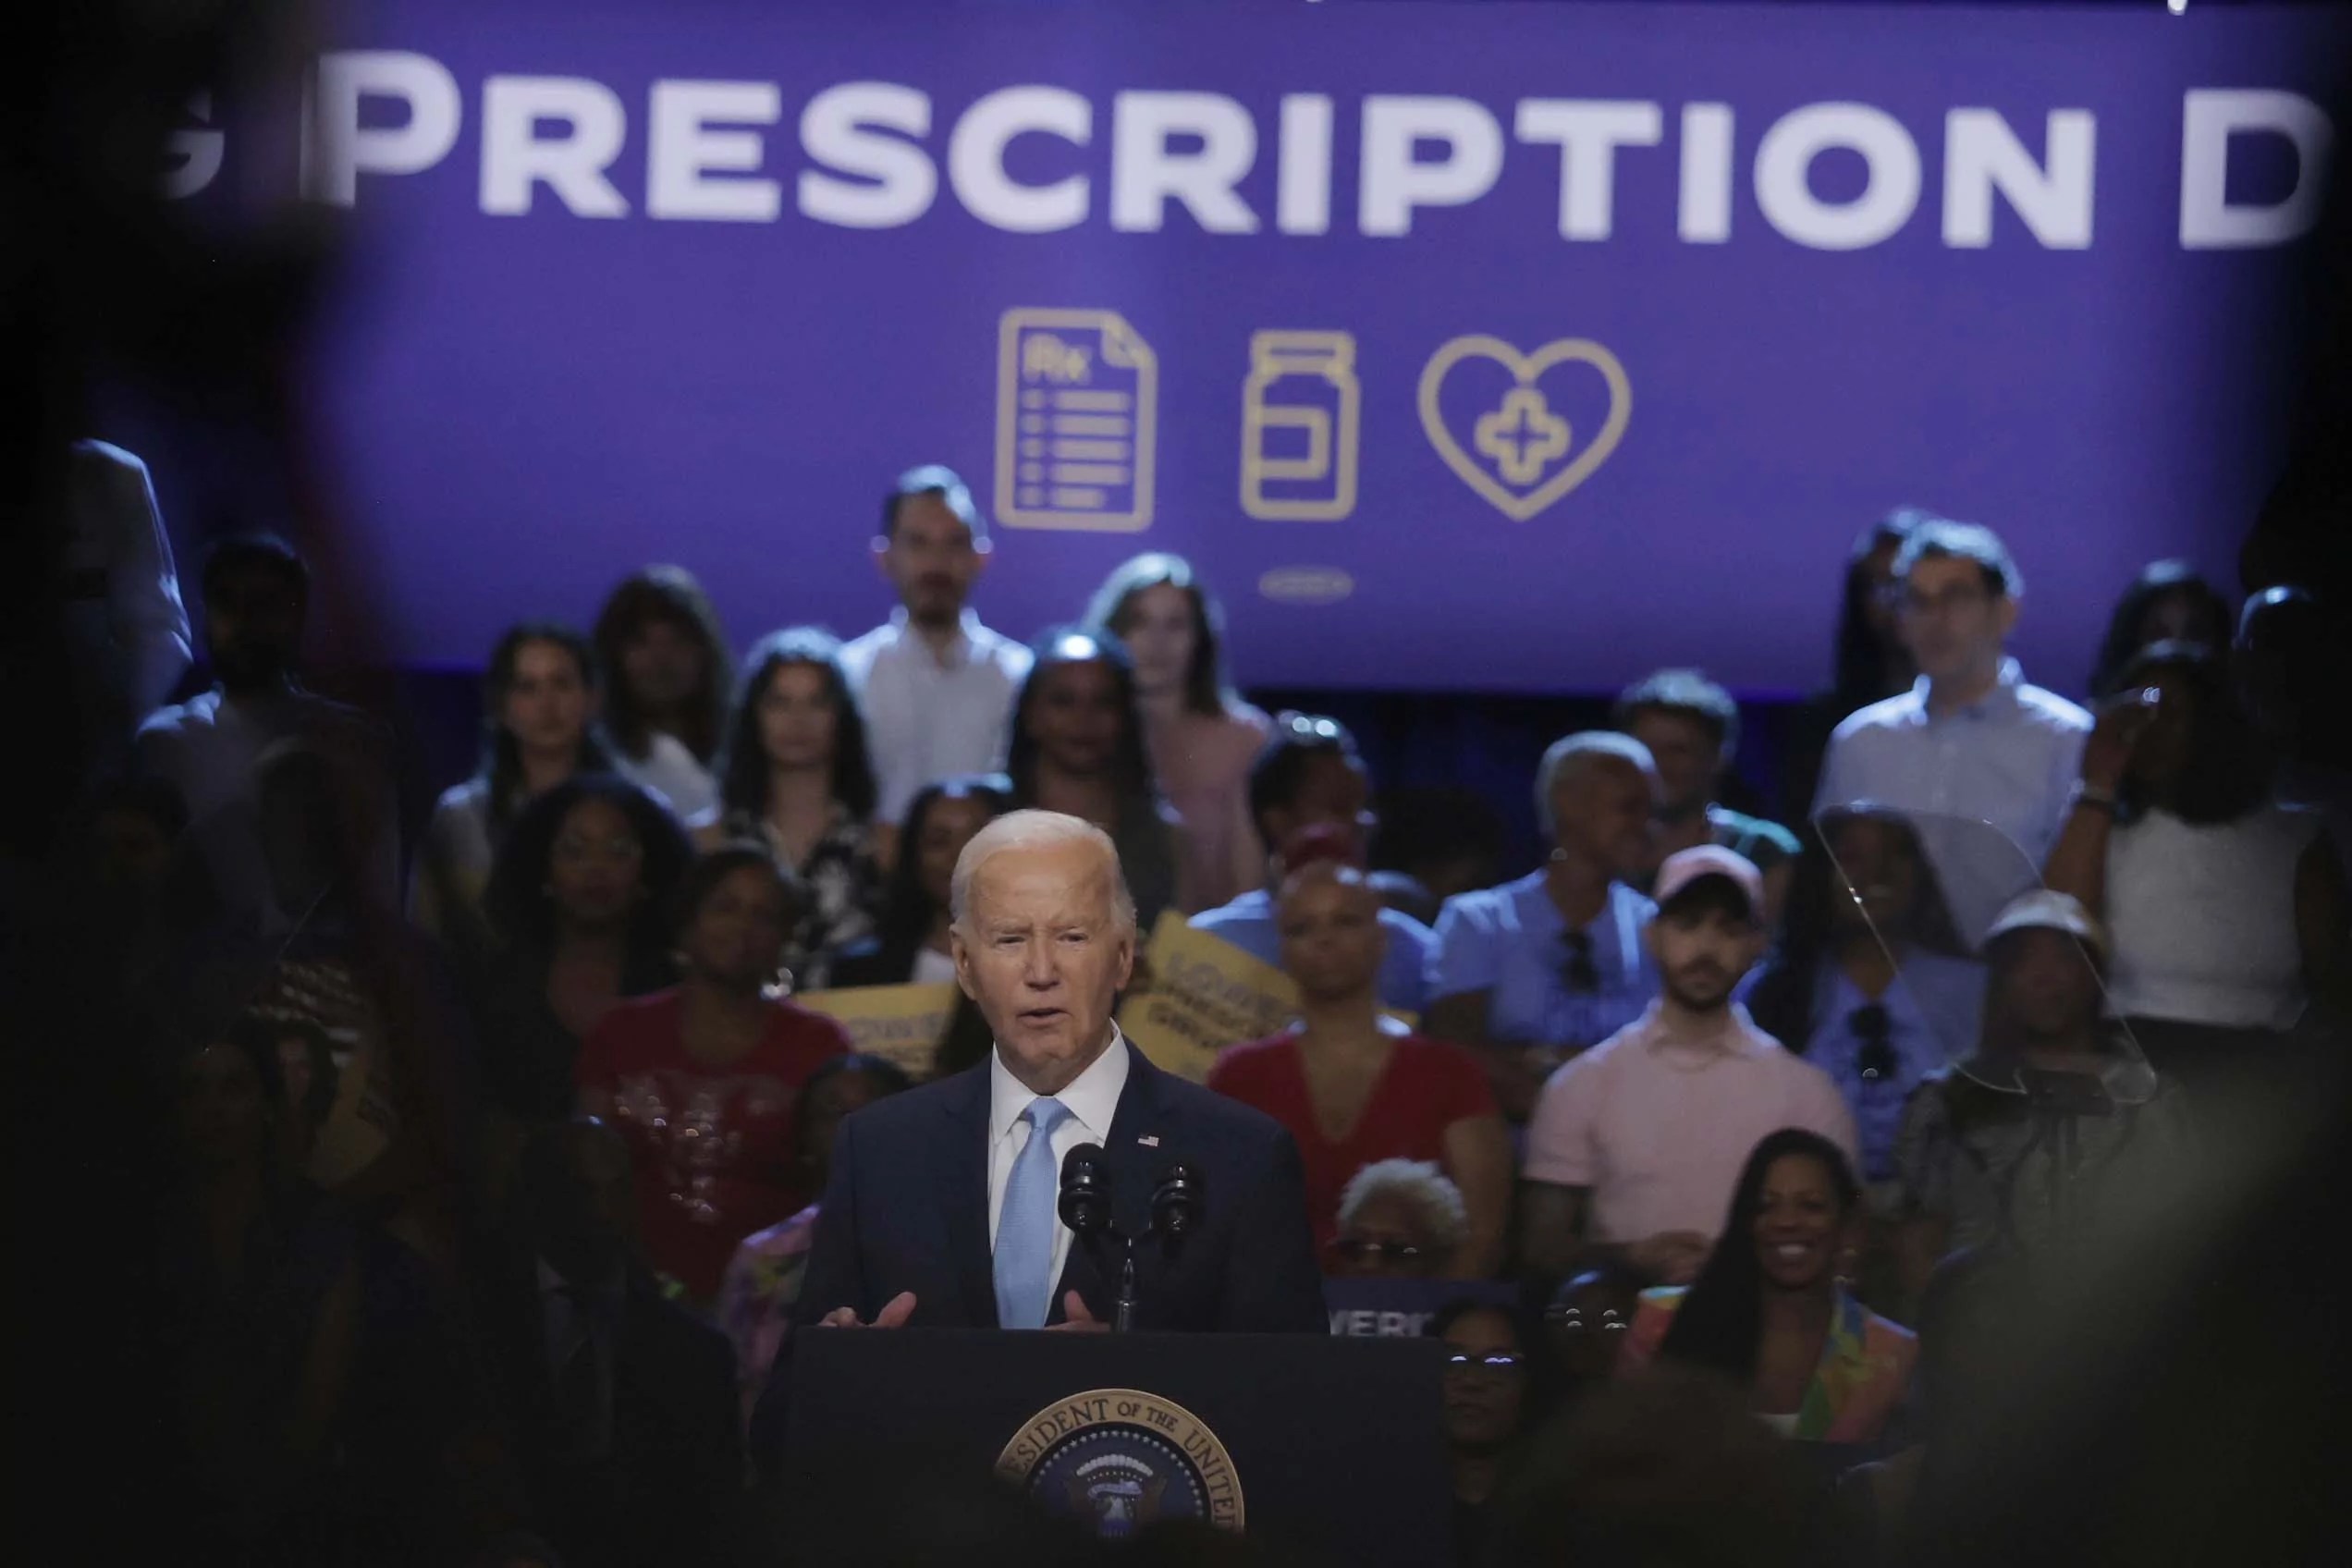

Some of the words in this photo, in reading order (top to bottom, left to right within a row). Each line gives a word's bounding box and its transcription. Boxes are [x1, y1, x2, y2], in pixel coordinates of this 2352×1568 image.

[300, 49, 2098, 251] PRESCRIPTION
[1005, 1398, 1109, 1474] ESIDENT
[1117, 1401, 1141, 1417] OF
[1146, 1406, 1178, 1433] THE
